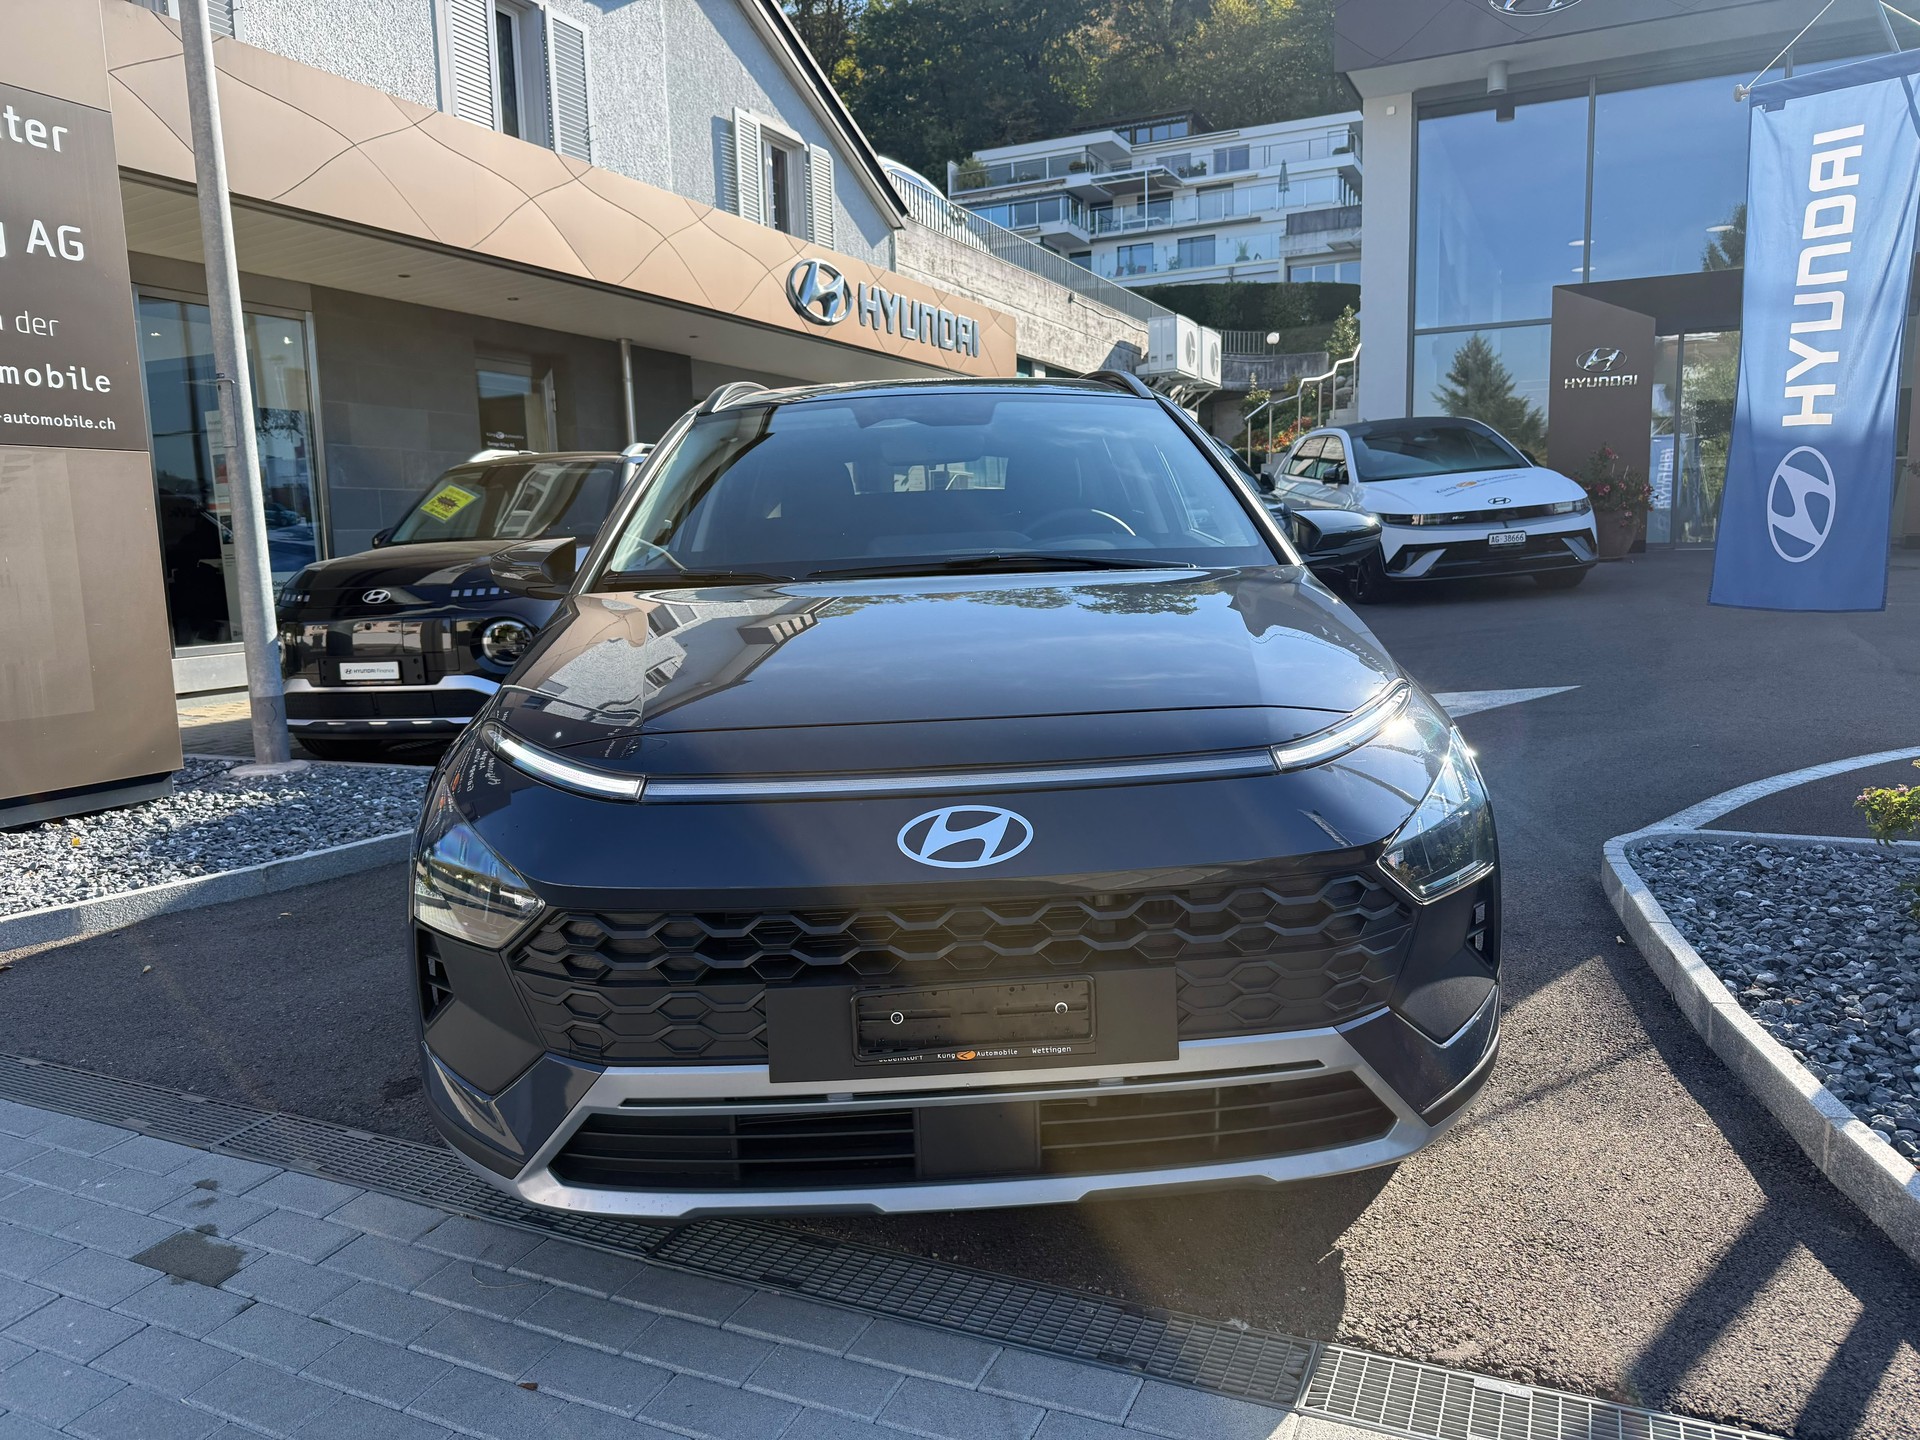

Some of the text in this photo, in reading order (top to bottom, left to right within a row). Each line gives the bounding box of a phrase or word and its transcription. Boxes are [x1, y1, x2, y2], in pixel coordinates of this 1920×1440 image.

[0, 105, 68, 152] ter
[26, 219, 85, 261] AG
[1782, 124, 1865, 427] HYUNDAI
[15, 310, 60, 336] der
[858, 280, 980, 358] HYUNDAI
[1564, 374, 1638, 389] HYUNDAI
[1503, 533, 1525, 543] 38666
[937, 1052, 956, 1060] Küng
[976, 1048, 1018, 1057] Automobile
[1031, 1046, 1072, 1055] Wettingen
